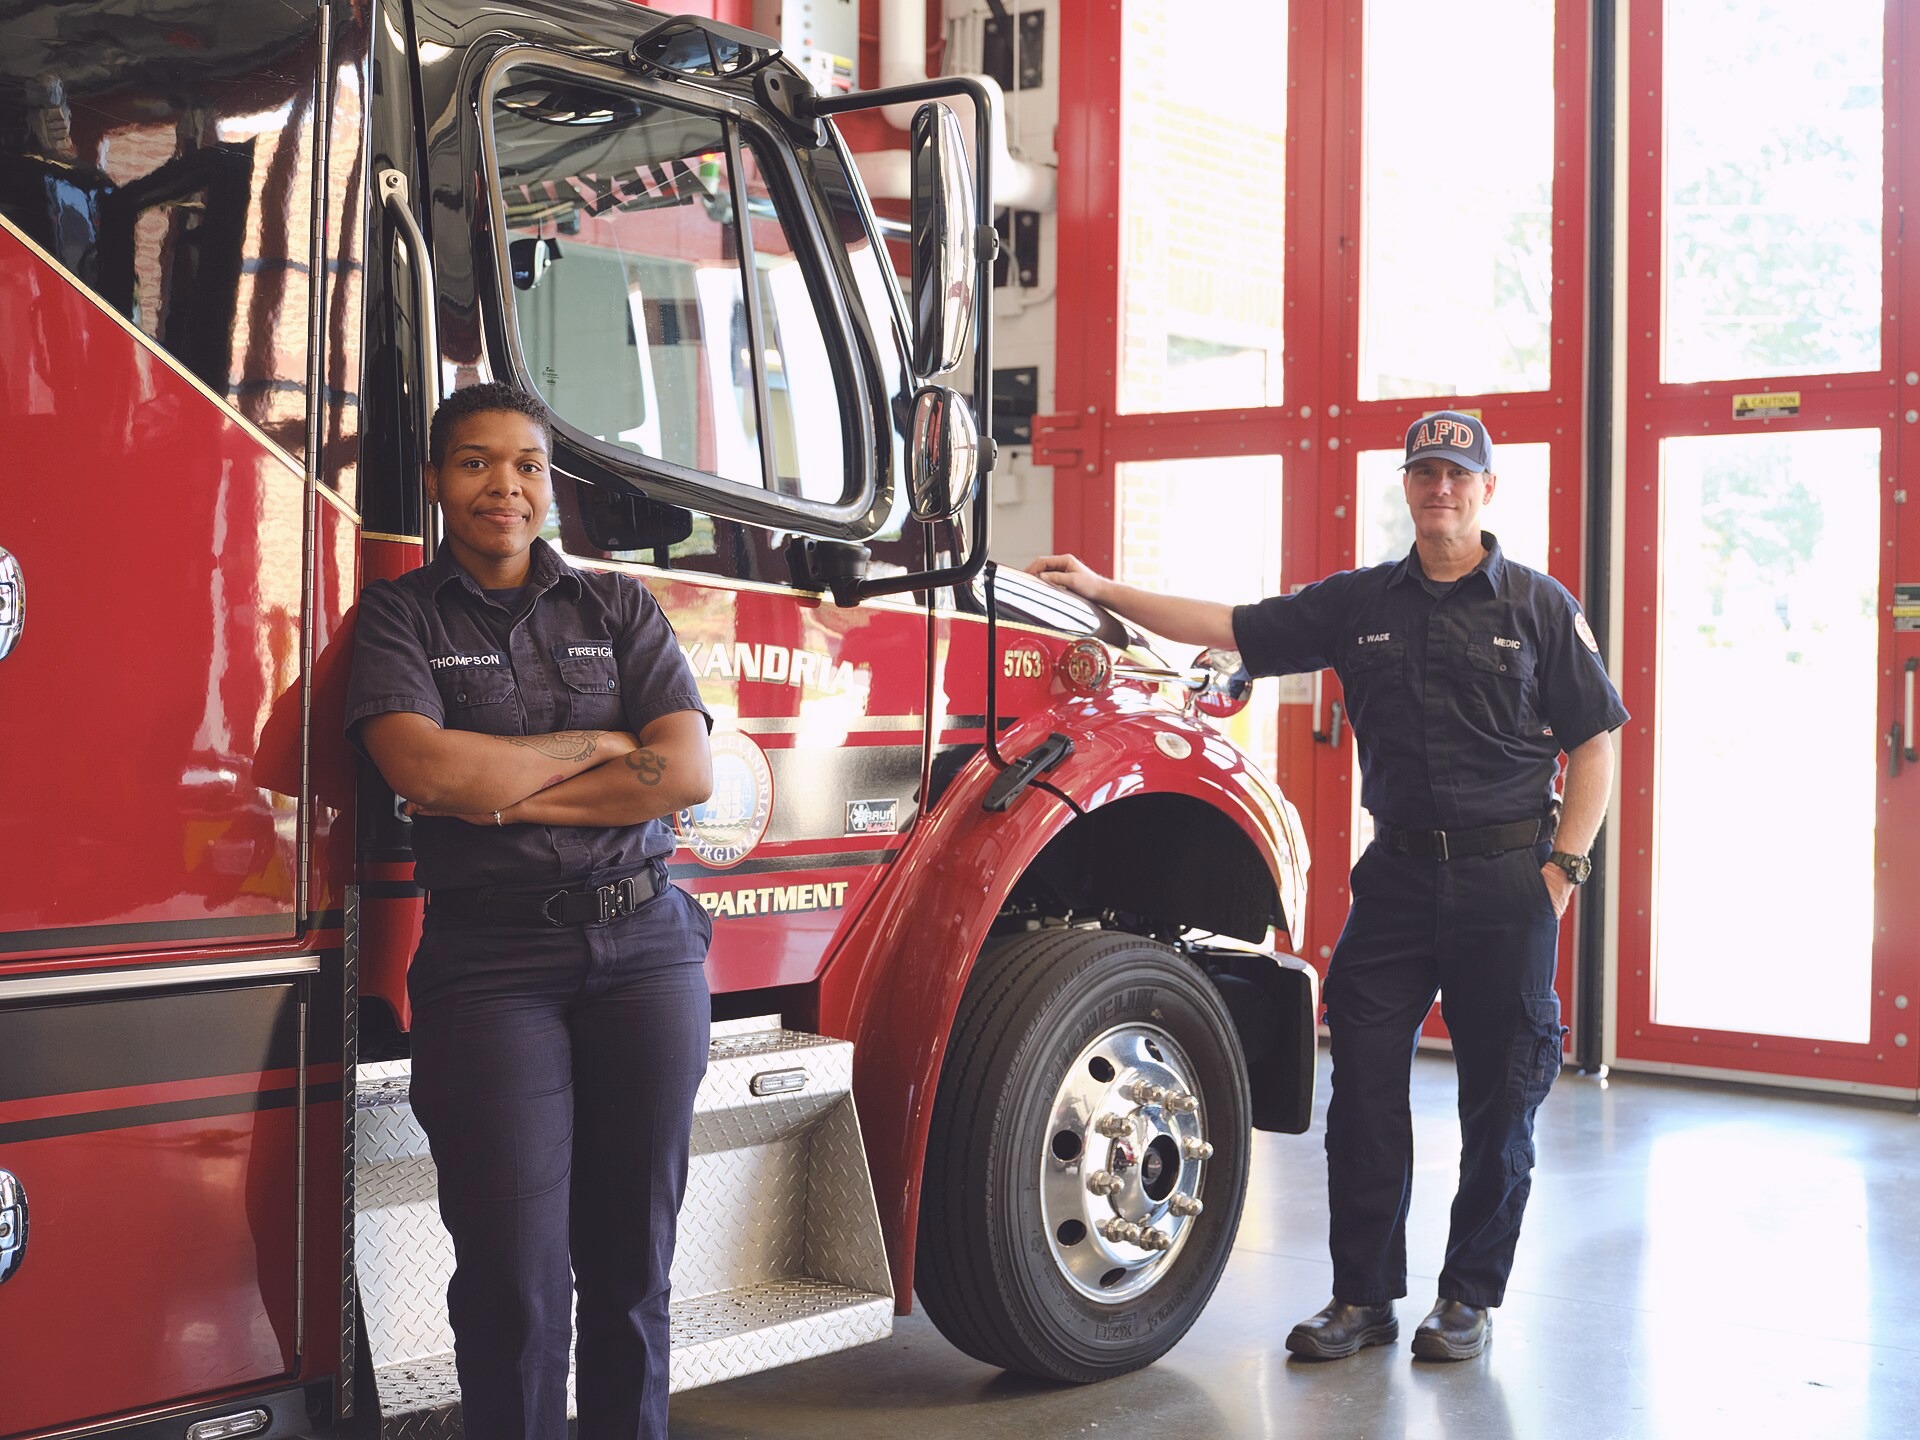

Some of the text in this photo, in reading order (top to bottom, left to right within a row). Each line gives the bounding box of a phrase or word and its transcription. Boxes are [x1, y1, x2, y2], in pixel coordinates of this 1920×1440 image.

[1752, 396, 1796, 406] CAUTION
[1413, 419, 1473, 452] AFD
[1367, 632, 1390, 642] WADE
[1493, 636, 1520, 649] MEDIC
[430, 654, 500, 669] THOMPSON
[1004, 650, 1042, 678] 5763
[688, 827, 759, 862] VIRGINIA
[690, 882, 849, 918] PARTMENT
[1044, 988, 1158, 1097] MICHELIN
